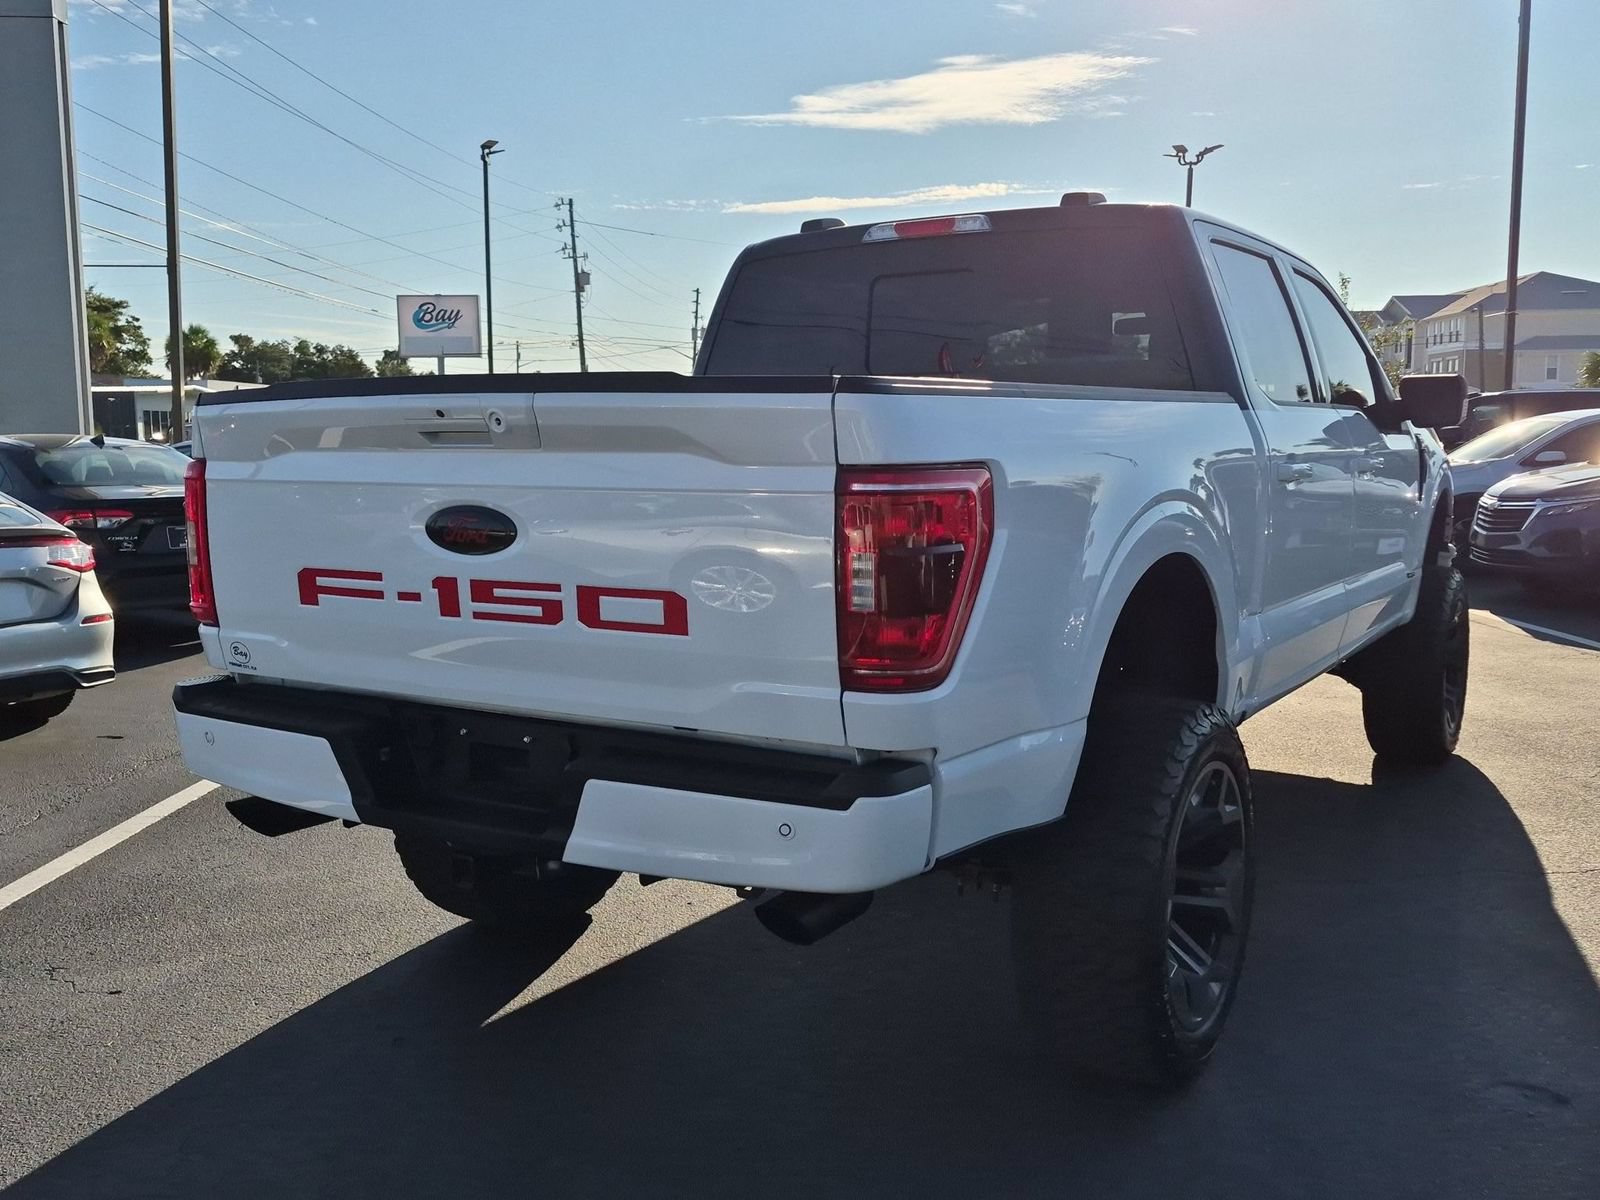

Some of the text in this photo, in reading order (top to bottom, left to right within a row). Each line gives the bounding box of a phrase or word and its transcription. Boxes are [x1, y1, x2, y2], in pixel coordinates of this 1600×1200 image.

[417, 302, 463, 329] Bay
[442, 515, 489, 544] Ford
[297, 568, 688, 635] F-150
[232, 645, 248, 660] Bay
